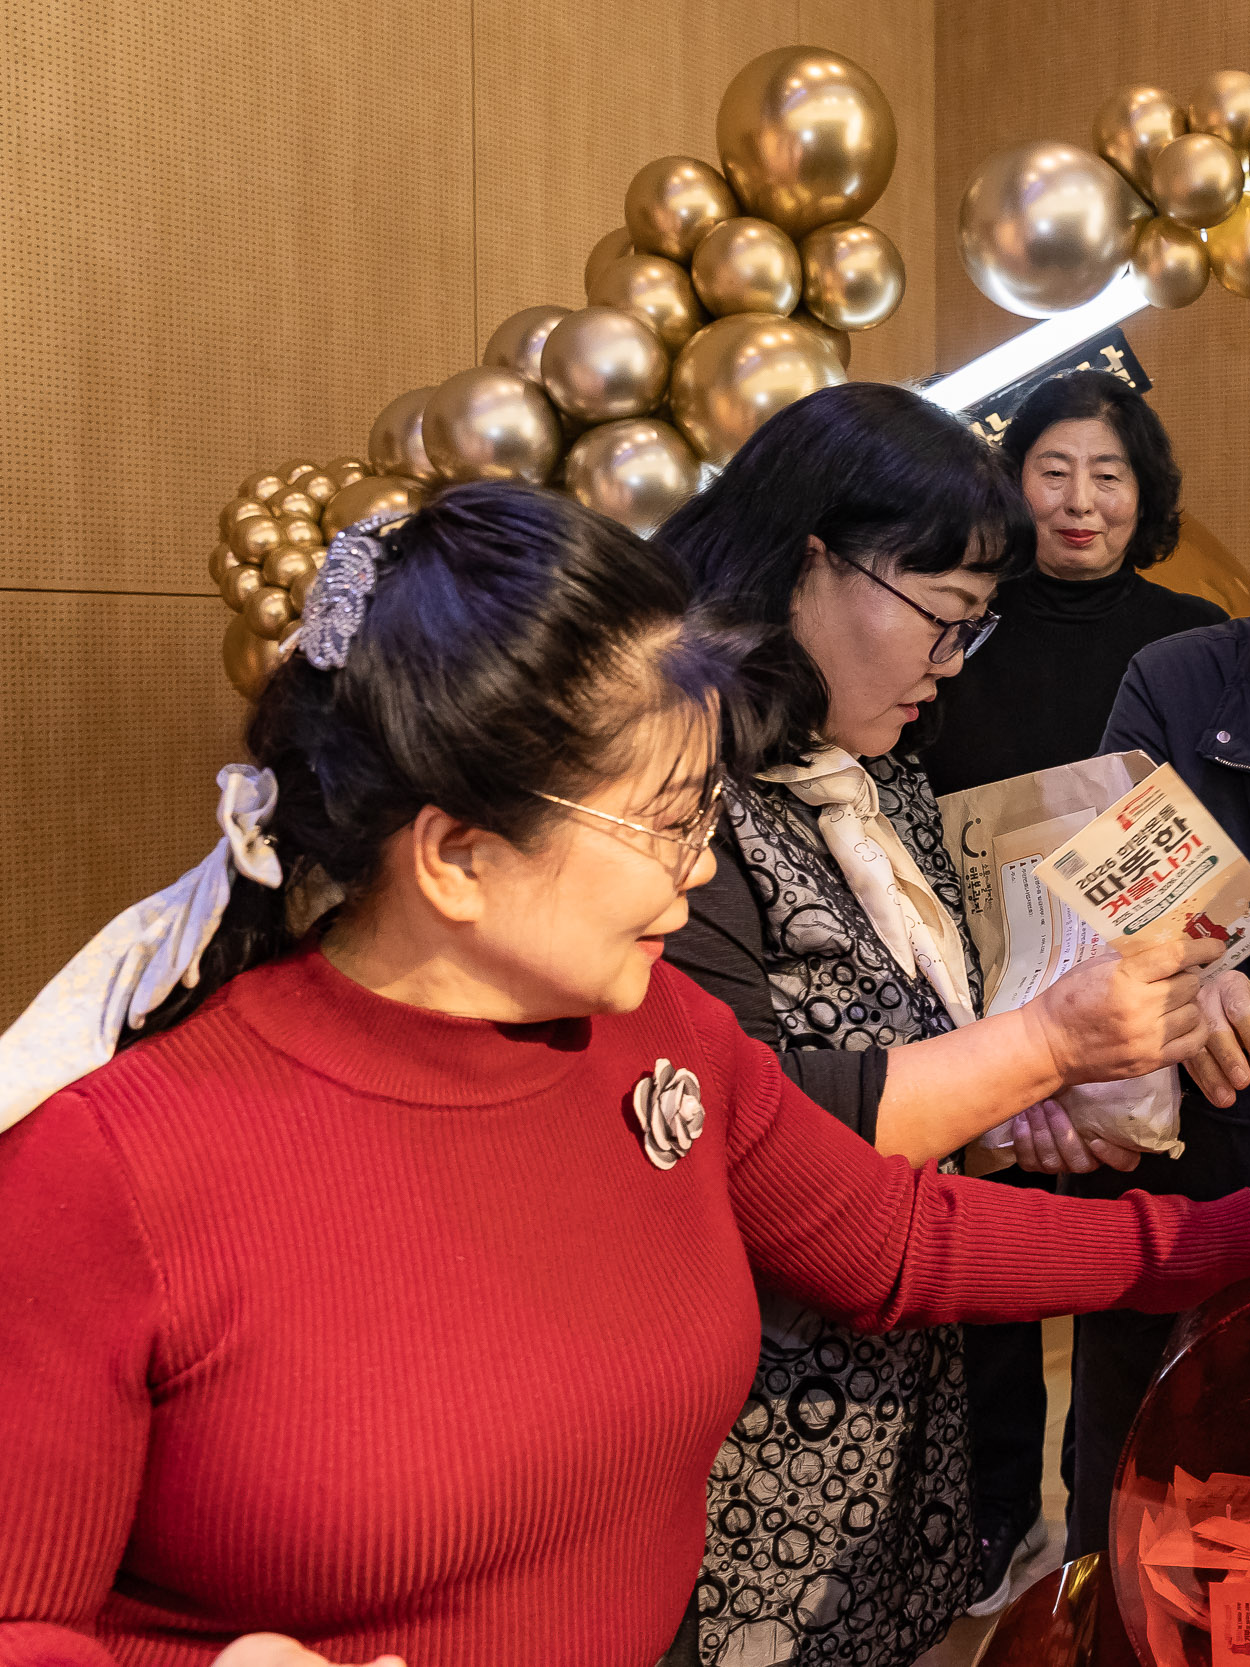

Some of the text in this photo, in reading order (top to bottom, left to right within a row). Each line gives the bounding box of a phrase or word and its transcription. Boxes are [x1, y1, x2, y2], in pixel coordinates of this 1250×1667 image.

[1076, 804, 1176, 890] 2026 희망온돌
[1084, 816, 1193, 906] 따뜻한
[1101, 834, 1204, 918] 겨울나기
[966, 866, 983, 914] 행복광진
